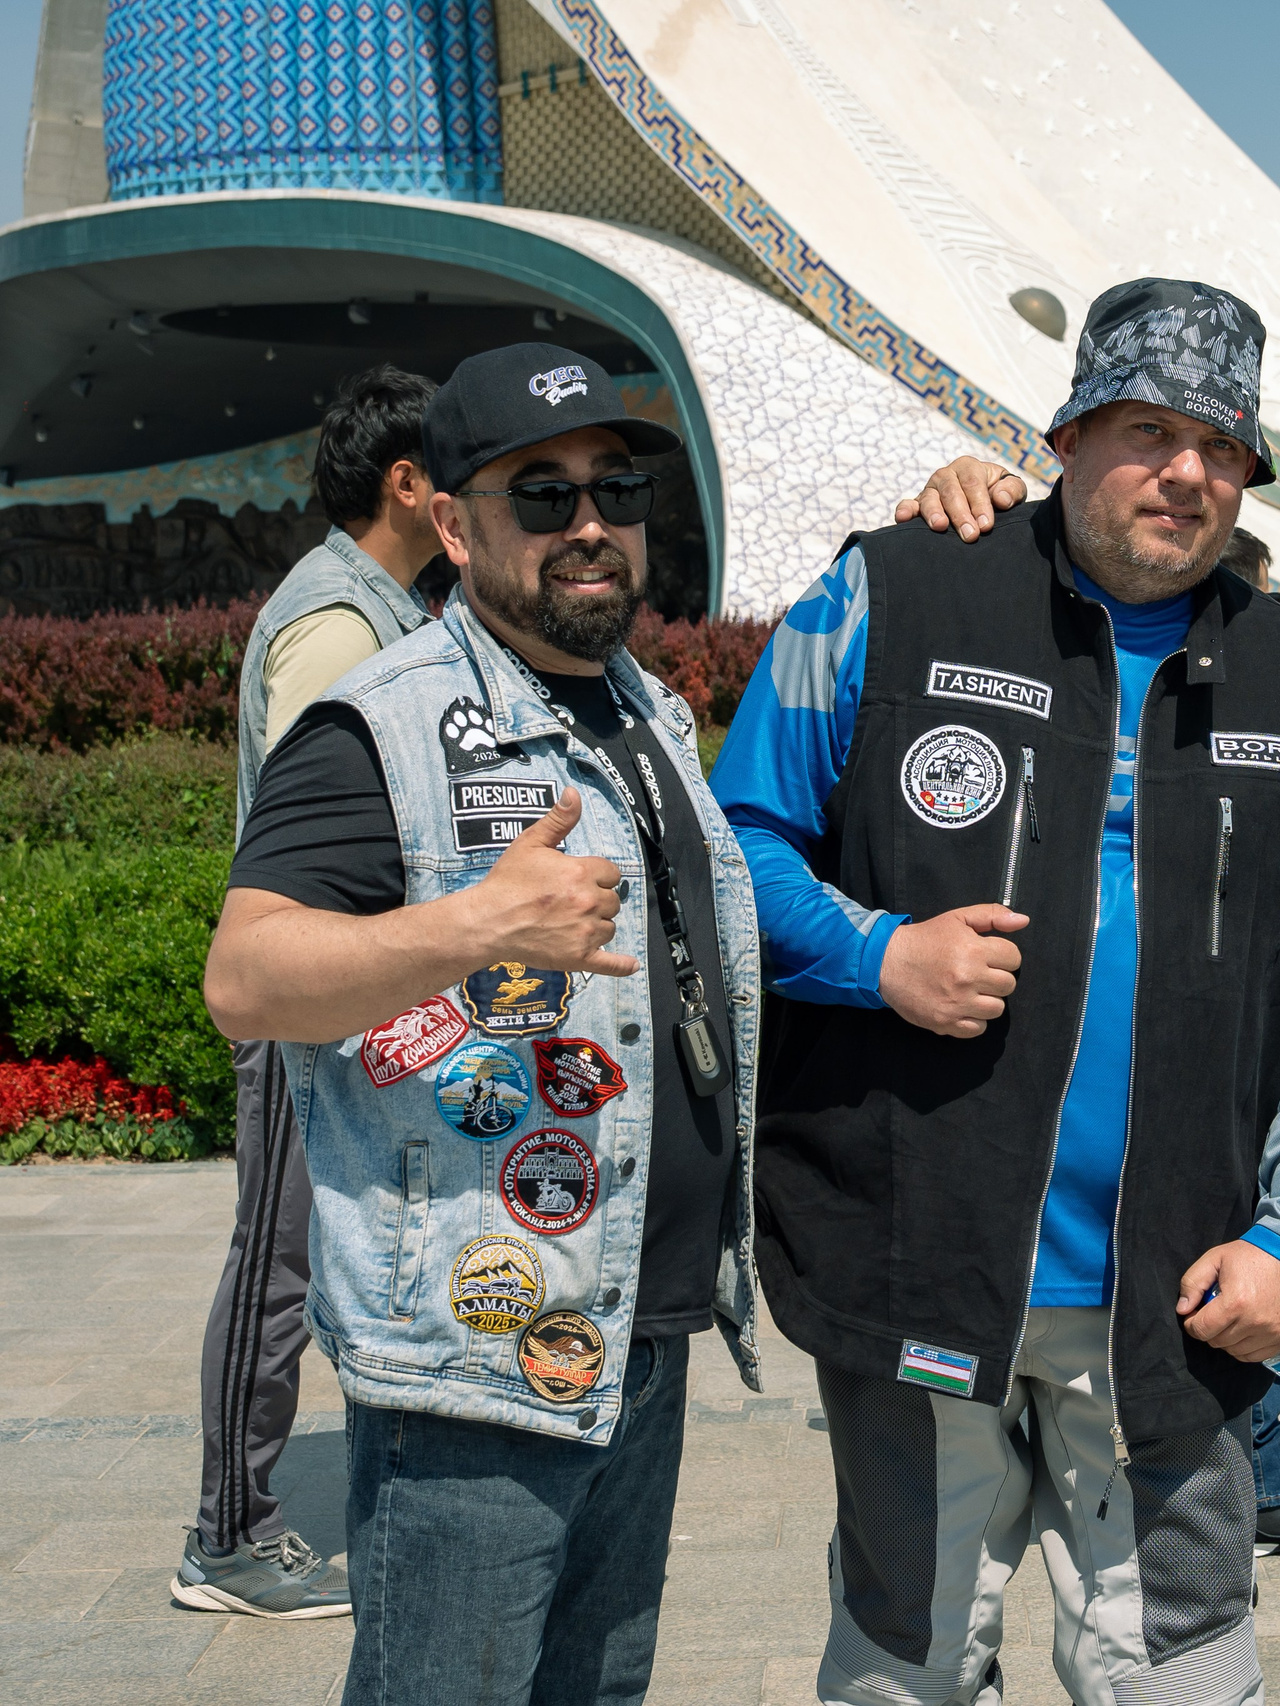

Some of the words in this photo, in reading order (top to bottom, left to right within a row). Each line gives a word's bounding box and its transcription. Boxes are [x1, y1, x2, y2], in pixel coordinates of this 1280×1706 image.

[529, 365, 588, 397] CZECH
[546, 381, 588, 406] Quality
[1184, 390, 1239, 421] DISCOVERY
[1186, 401, 1236, 430] BOROVOE
[936, 671, 1047, 707] TASHKENT
[472, 750, 501, 763] 2026
[913, 738, 949, 780] АССОЦИАЦИЯ
[955, 737, 994, 792] МОТОЦИКЛИСТОВ
[594, 747, 636, 806] adidas
[637, 753, 662, 809] adidas
[461, 786, 547, 807] PRESIDENT
[486, 1014, 525, 1027] ЖЕТИ
[528, 1011, 557, 1024] ЖЕР
[491, 1006, 513, 1015] семь
[516, 1003, 547, 1014] земель
[375, 1057, 401, 1080] ПУТЬ
[401, 1020, 462, 1068] КОЧЕВНИКА
[468, 1045, 521, 1070] ЦЕНТРАЛЬНОЙ
[516, 1069, 529, 1090] АЗИИ
[553, 1057, 601, 1083] МОТОСЕЗОНА
[561, 1053, 602, 1076] ОТКРЫТИЕ
[546, 1084, 564, 1106] ТЕМИР
[564, 1101, 589, 1110] ТУЛПАР
[560, 1090, 580, 1103] 2025
[563, 1083, 580, 1095] ОШ
[504, 1135, 543, 1191] ОТКРЫТИЕ
[545, 1132, 596, 1192] МОТОСЕЗОНА
[452, 1237, 506, 1299] ЦЕНТРАЛЬНО-АЗИАТСКОЕ
[507, 1238, 536, 1263] ОТКРЫТИЕ
[458, 1297, 534, 1321] АЛМАТЫ
[478, 1314, 510, 1330] 2025
[558, 1323, 578, 1333] 2026
[532, 1361, 558, 1374] ТЕМИР
[559, 1367, 587, 1380] ТУЛПАР
